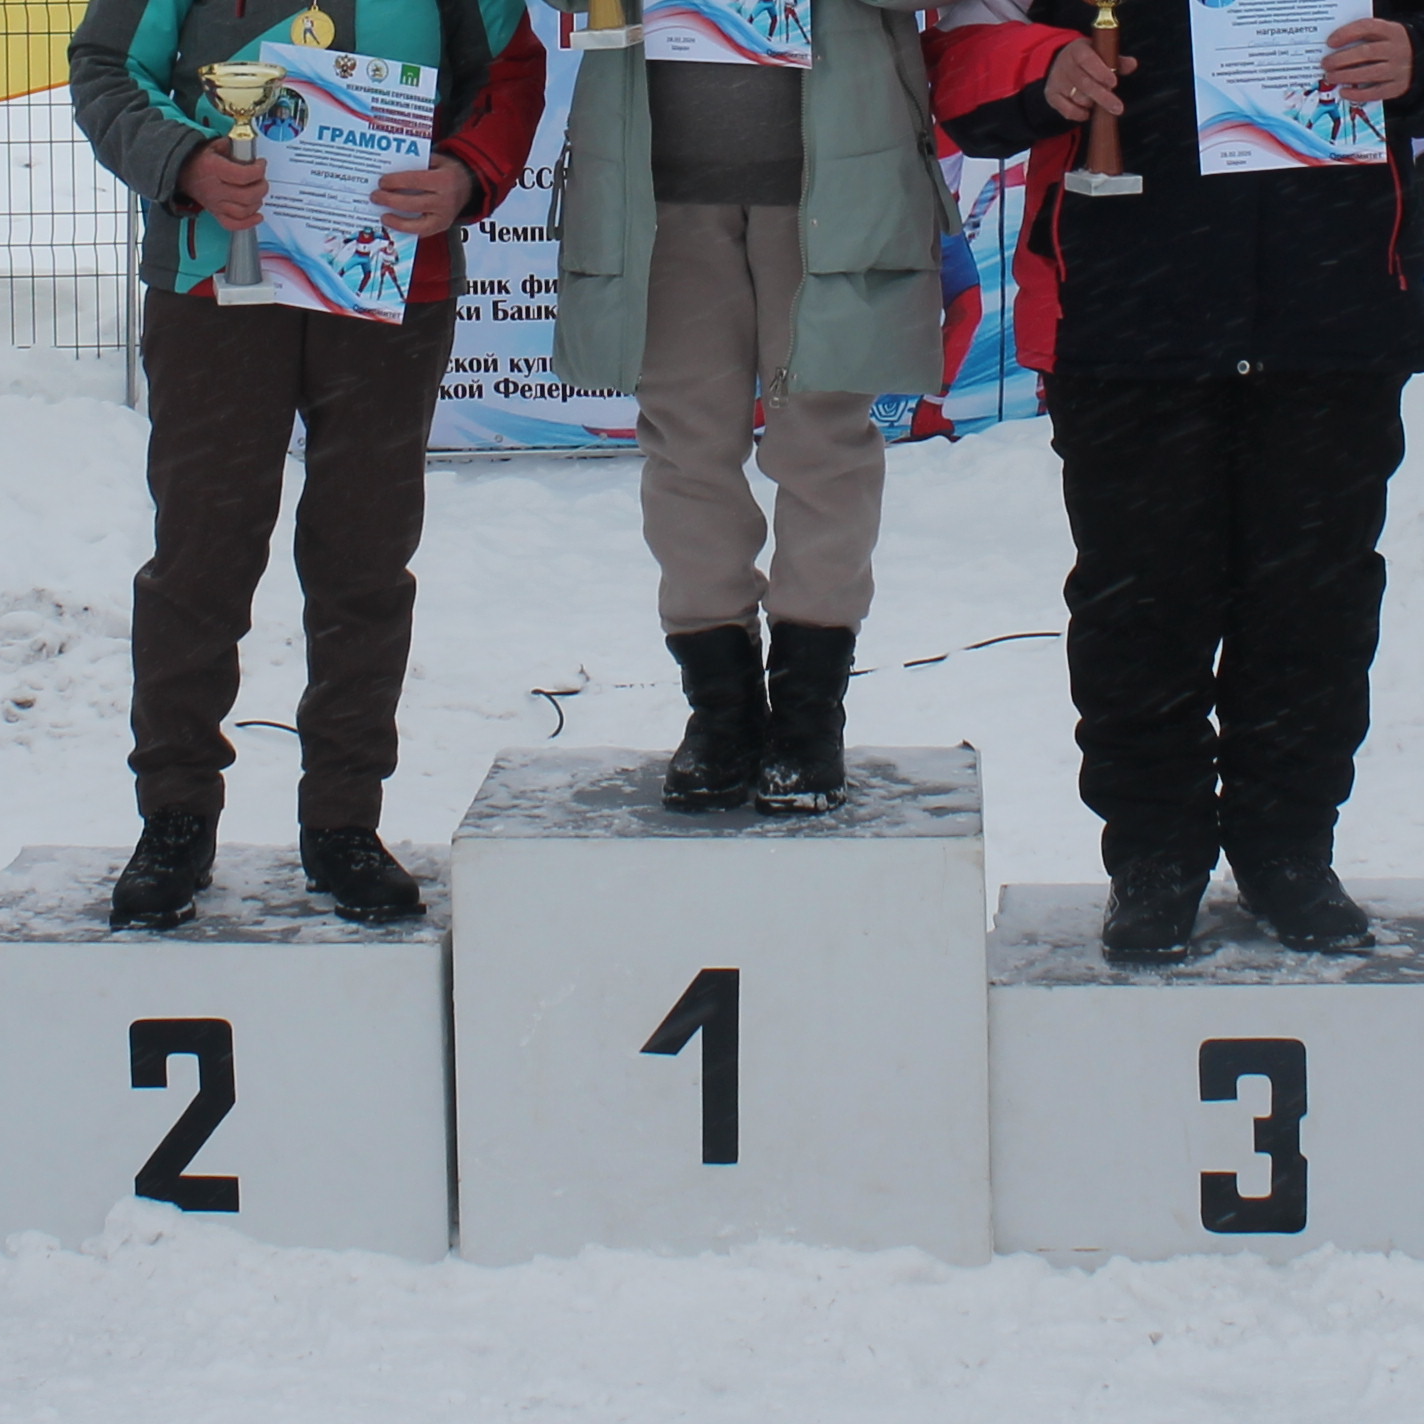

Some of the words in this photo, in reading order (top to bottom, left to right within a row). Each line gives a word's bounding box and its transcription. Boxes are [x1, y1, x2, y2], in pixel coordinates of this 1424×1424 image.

[317, 125, 421, 157] ГРАМОТА
[465, 279, 511, 296] ник
[520, 274, 559, 299] фи
[456, 305, 481, 321] ки
[491, 299, 558, 322] Башк
[439, 378, 484, 400] кой
[641, 969, 739, 1165] 1
[130, 1019, 240, 1217] 2
[1199, 1039, 1308, 1234] 3
